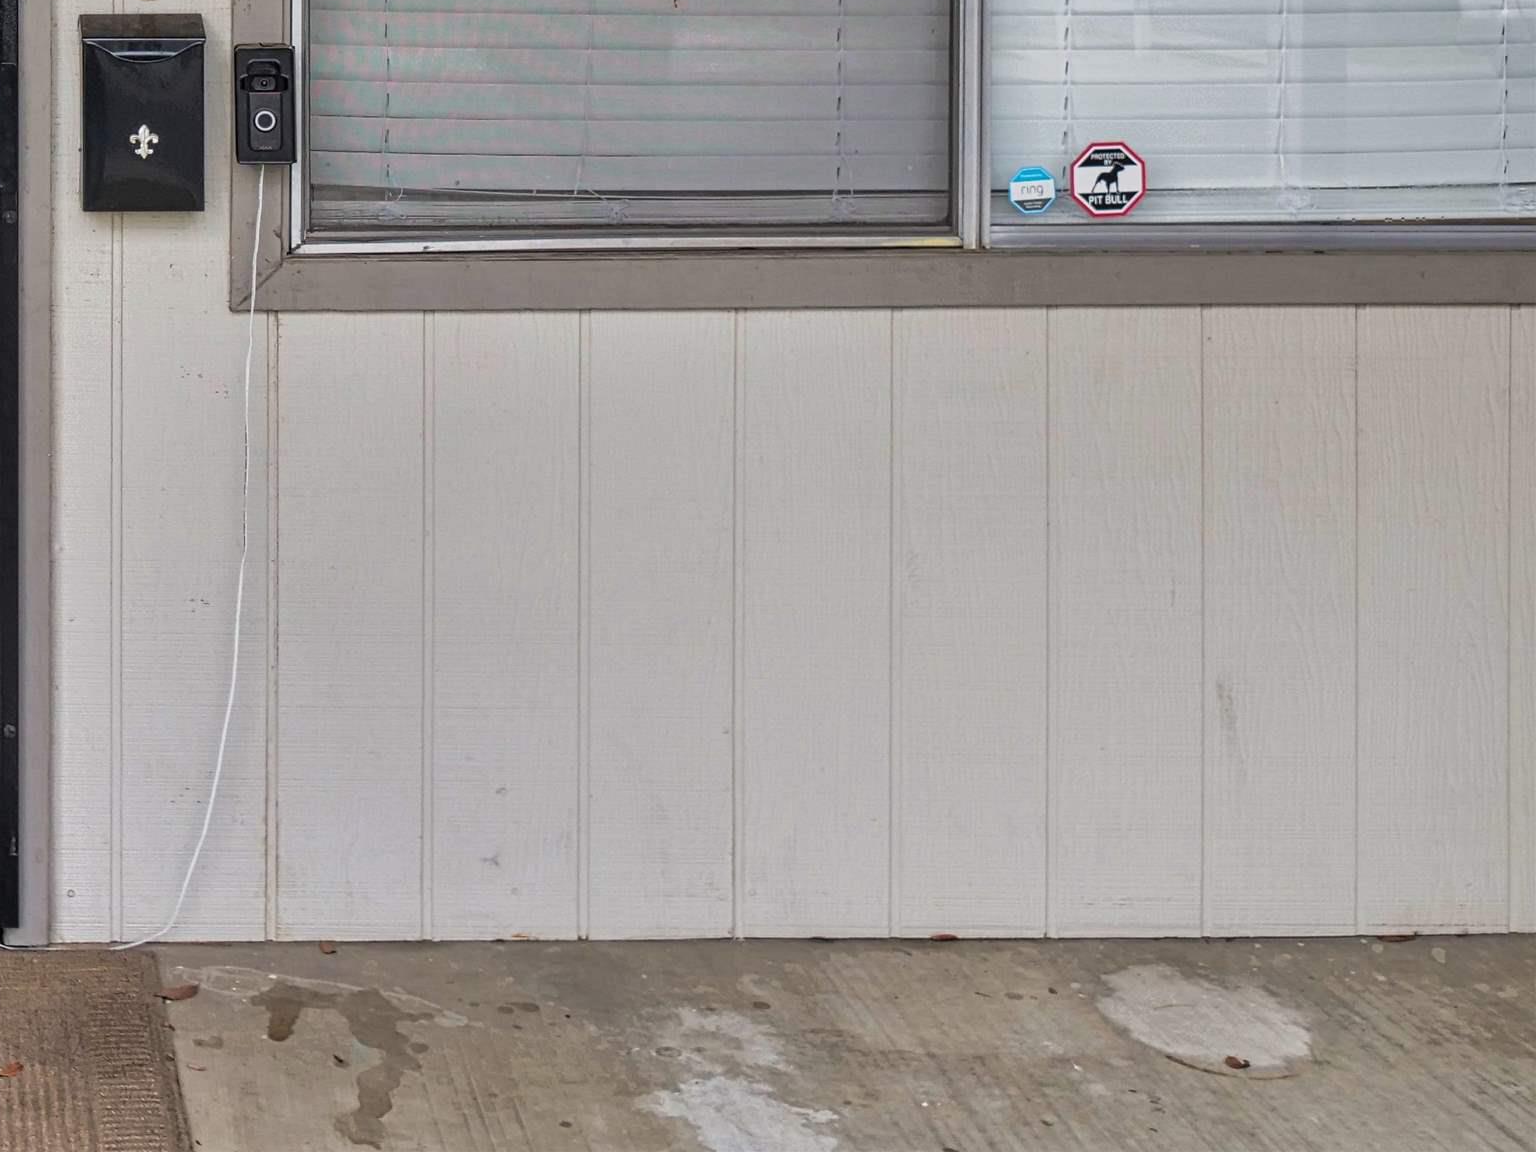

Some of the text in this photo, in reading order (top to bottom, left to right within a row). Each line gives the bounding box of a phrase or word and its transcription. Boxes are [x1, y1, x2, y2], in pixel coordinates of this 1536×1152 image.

[1090, 152, 1125, 160] PROTECTED
[1020, 184, 1044, 196] ring
[1088, 194, 1128, 206] PIT BULL
